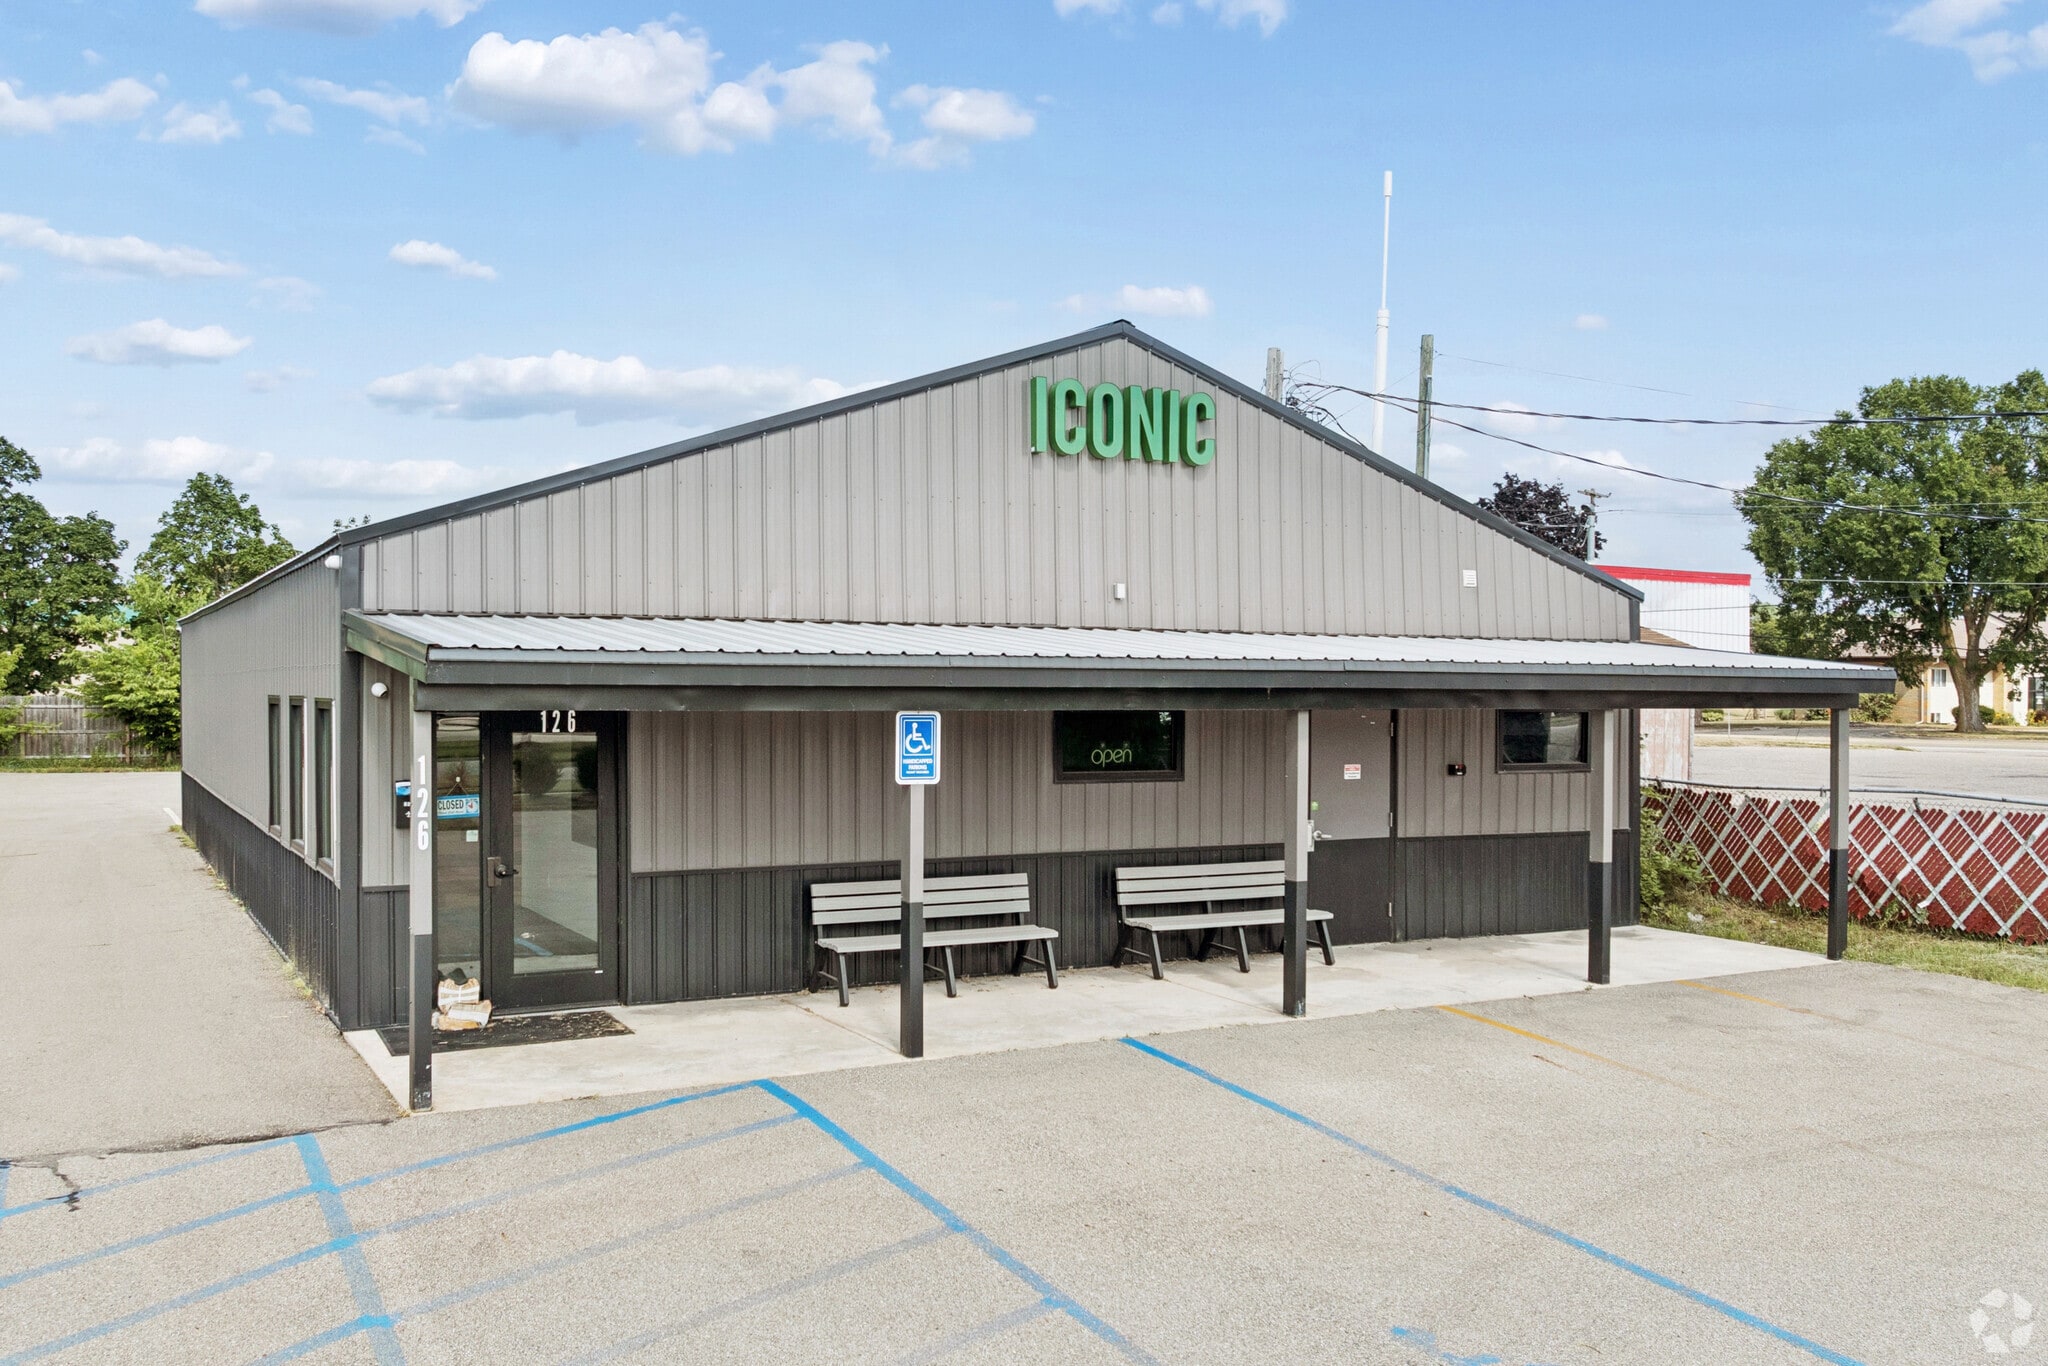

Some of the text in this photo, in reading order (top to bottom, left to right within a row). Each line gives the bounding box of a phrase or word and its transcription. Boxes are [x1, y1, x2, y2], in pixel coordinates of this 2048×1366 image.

[1030, 376, 1216, 467] ICONIC
[540, 710, 576, 733] 126
[1091, 749, 1132, 767] open
[417, 755, 429, 850] 126
[438, 799, 464, 810] CLOSED
